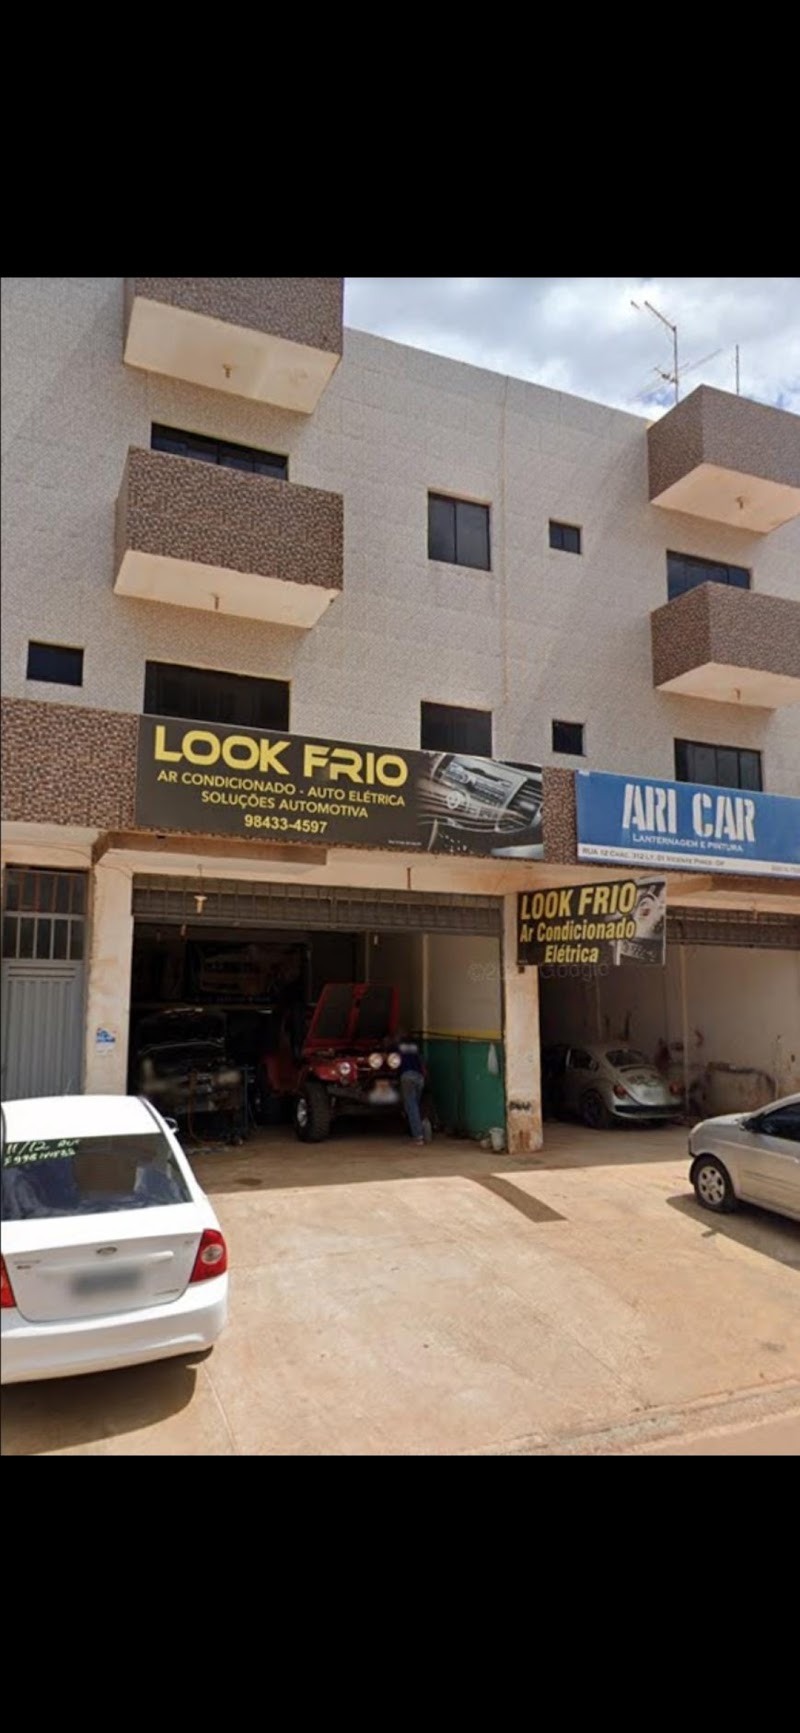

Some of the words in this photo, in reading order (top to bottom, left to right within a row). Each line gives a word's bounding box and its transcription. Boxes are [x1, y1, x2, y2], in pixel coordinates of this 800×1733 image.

[154, 724, 290, 775] LOOK
[303, 745, 408, 787] FRIO
[157, 769, 178, 784] AR
[181, 771, 296, 796] CONDICIONADO
[307, 786, 345, 801] AUTO
[348, 788, 405, 807] ELÉTRICA
[201, 789, 275, 809] SOLUÇÕES
[279, 799, 368, 818] AUTOMOTIVA
[244, 813, 328, 834] 98433-4597
[622, 783, 677, 835] ARI
[692, 792, 757, 843] CAR
[520, 886, 574, 920] LOOK
[578, 881, 637, 916] FRIO
[520, 923, 534, 943] Ar
[537, 918, 636, 942] Condicionado
[544, 943, 600, 965] Elétrica
